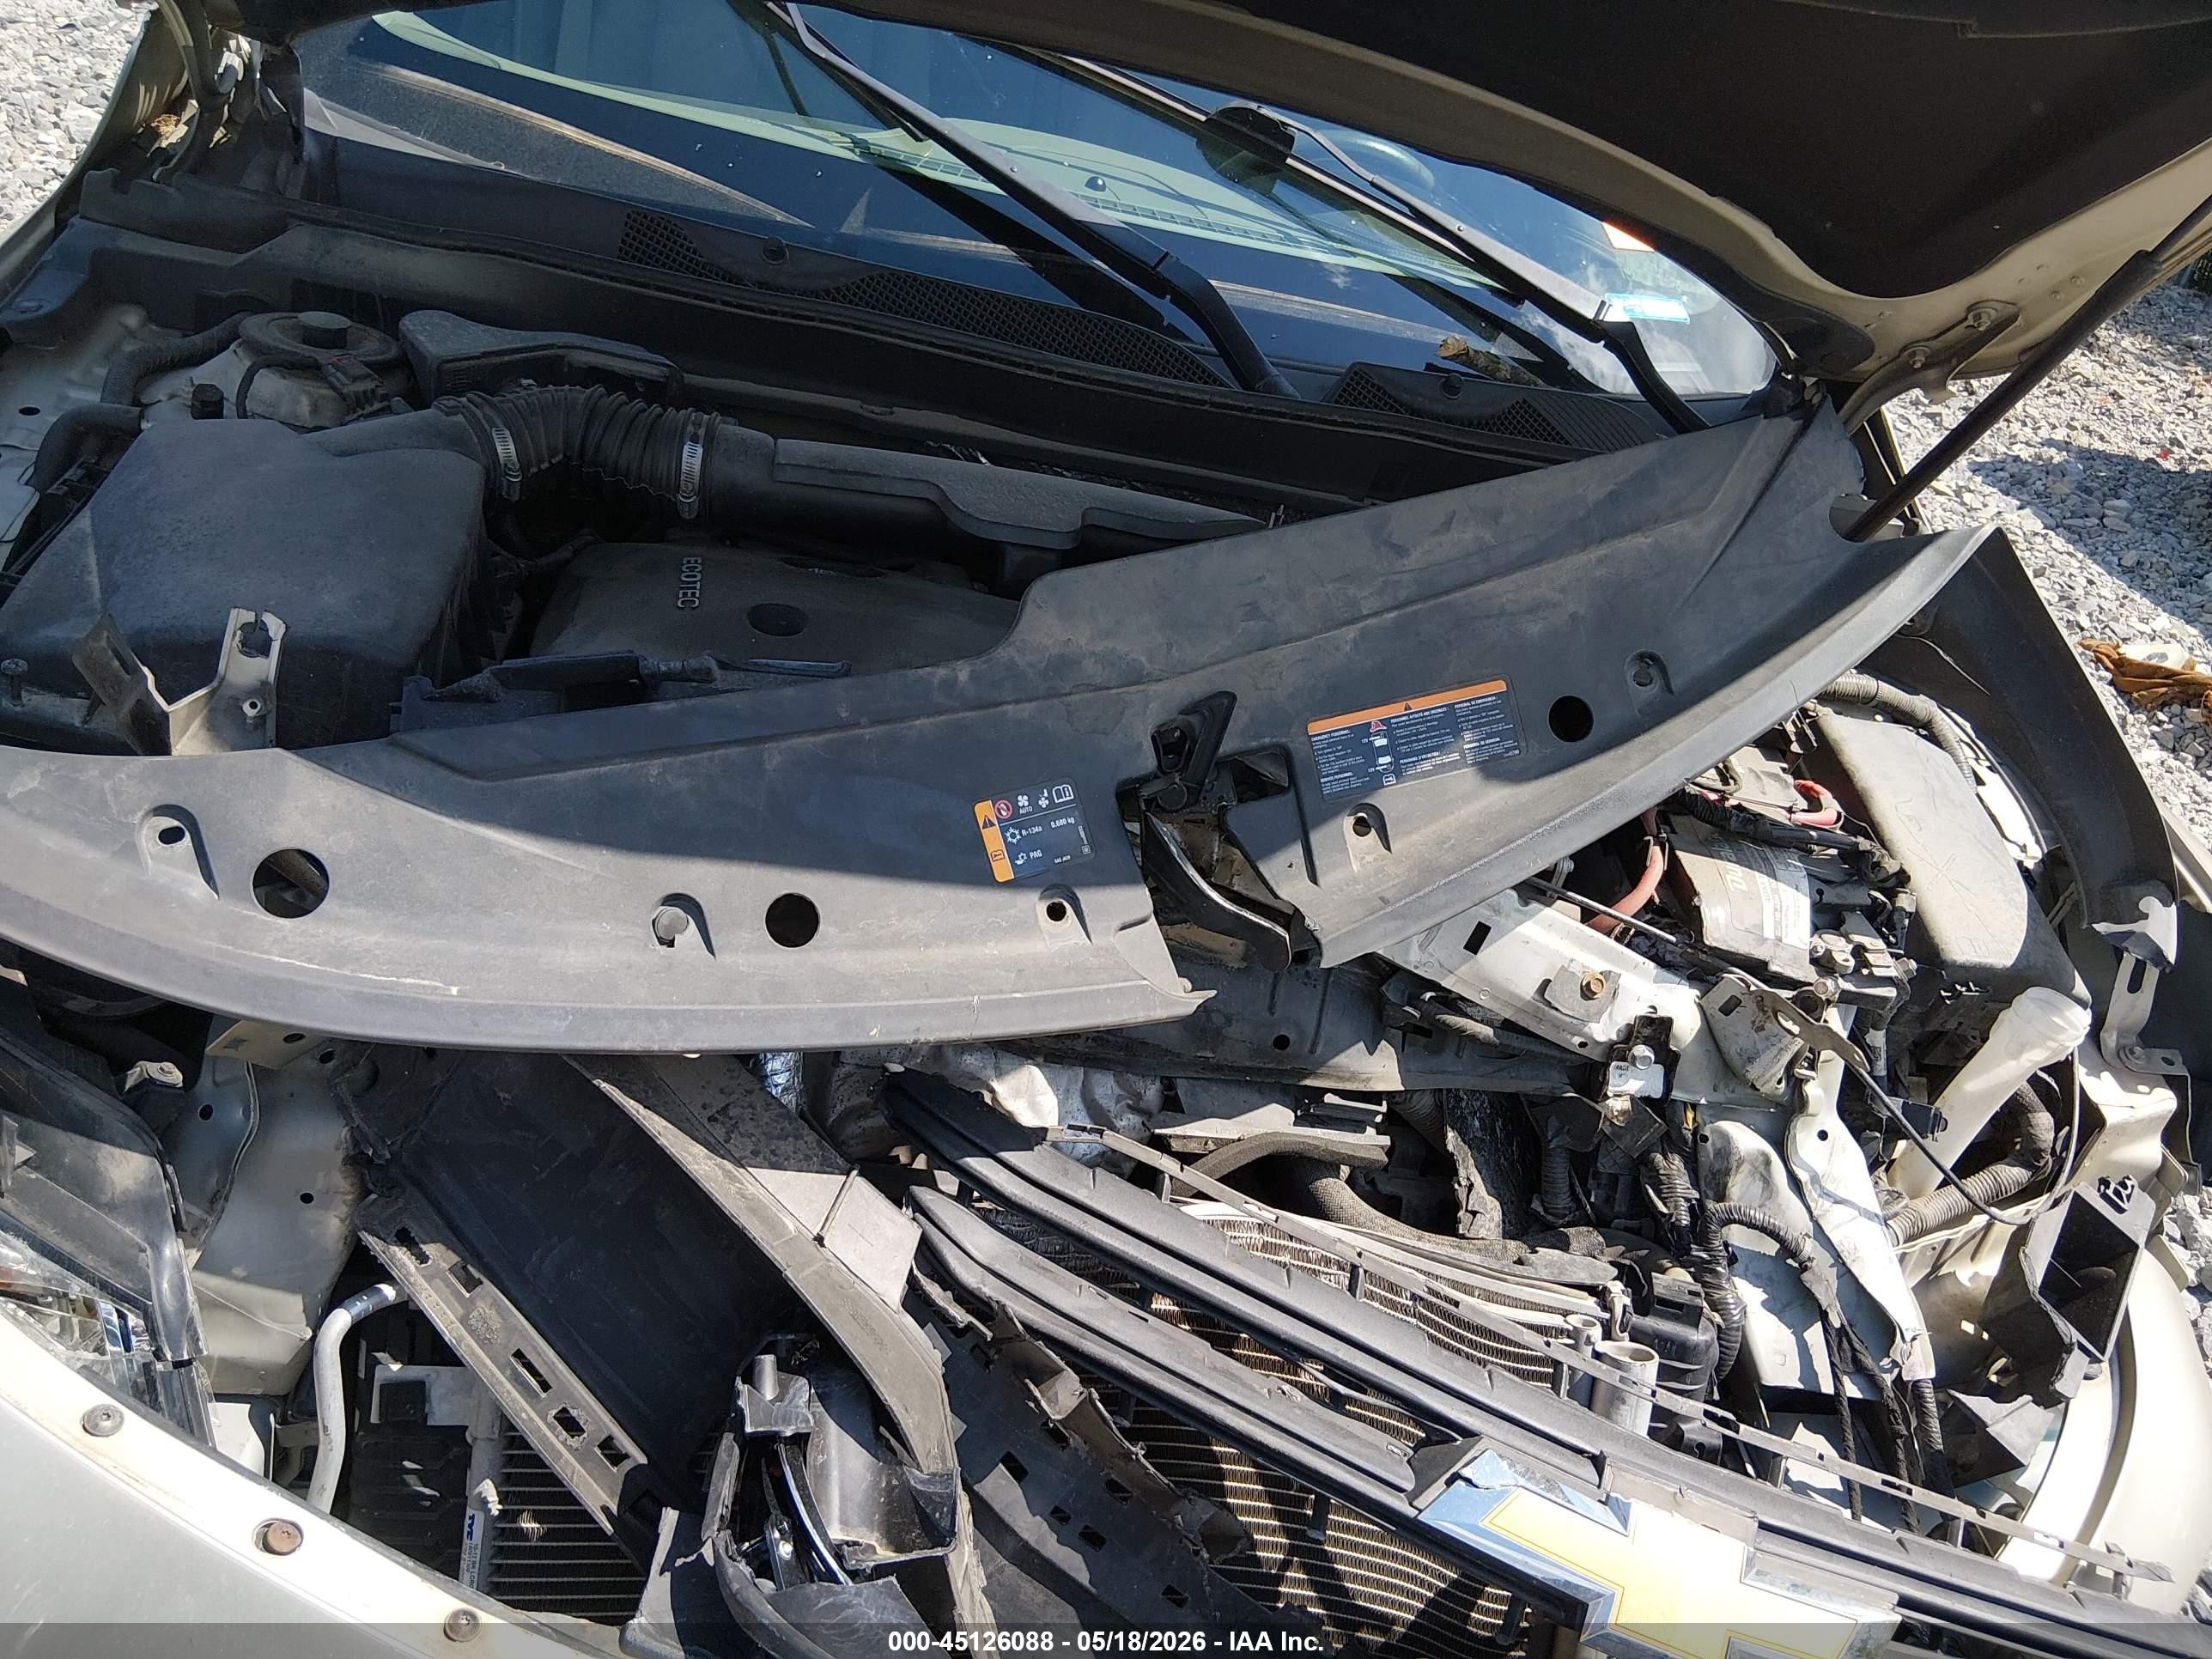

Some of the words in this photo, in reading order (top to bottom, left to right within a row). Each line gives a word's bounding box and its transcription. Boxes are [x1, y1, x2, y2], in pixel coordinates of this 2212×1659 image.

[677, 556, 702, 609] ECOTEC
[1019, 805, 1033, 815] AUTO
[1021, 825, 1042, 837] R-134a
[1067, 816, 1075, 825] kg
[1030, 849, 1042, 860] PAG
[466, 1513, 475, 1541] TYC
